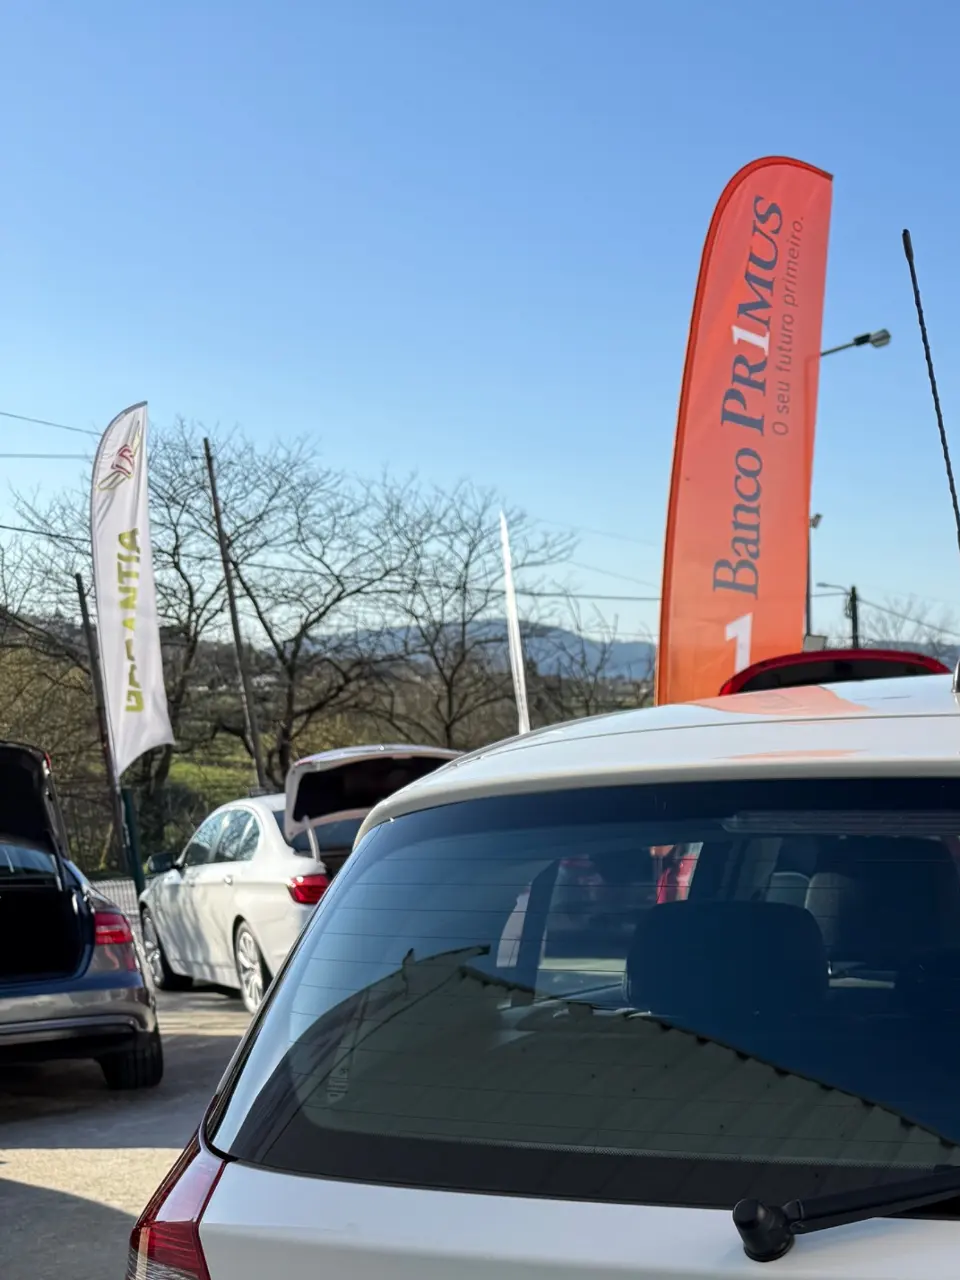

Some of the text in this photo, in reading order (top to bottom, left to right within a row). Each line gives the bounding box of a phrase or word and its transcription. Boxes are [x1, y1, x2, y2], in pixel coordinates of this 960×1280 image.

[772, 216, 805, 436] O seu futuro primeiro.
[712, 447, 763, 600] Banco
